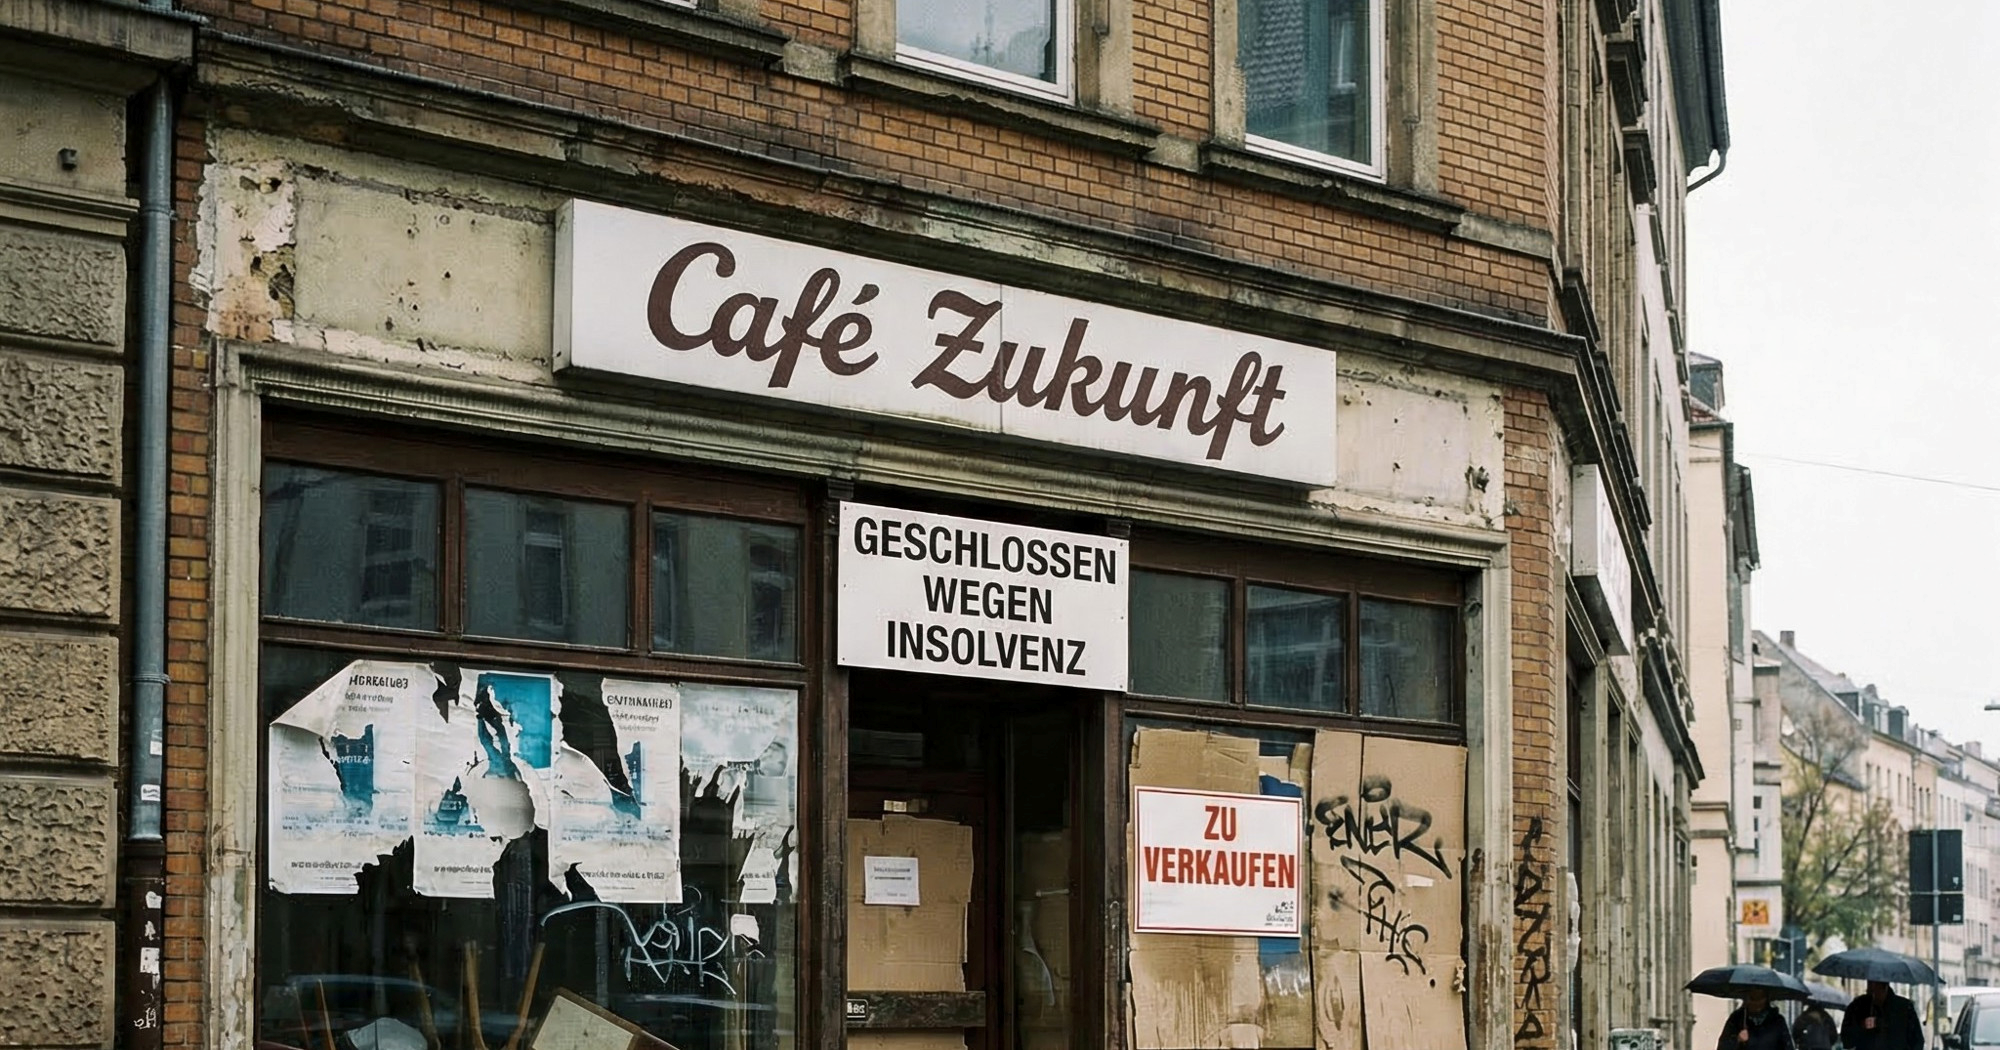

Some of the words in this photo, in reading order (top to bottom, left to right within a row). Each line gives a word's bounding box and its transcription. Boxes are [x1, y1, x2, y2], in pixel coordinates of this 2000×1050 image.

[647, 242, 880, 388] Café
[911, 289, 1287, 460] Zukunft
[854, 516, 1117, 585] GESCHLOSSEN
[923, 575, 1052, 625] WEGEN
[887, 620, 1086, 676] INSOLVENZ
[1204, 805, 1237, 842] ZU
[1144, 846, 1295, 889] VERKAUFEN
